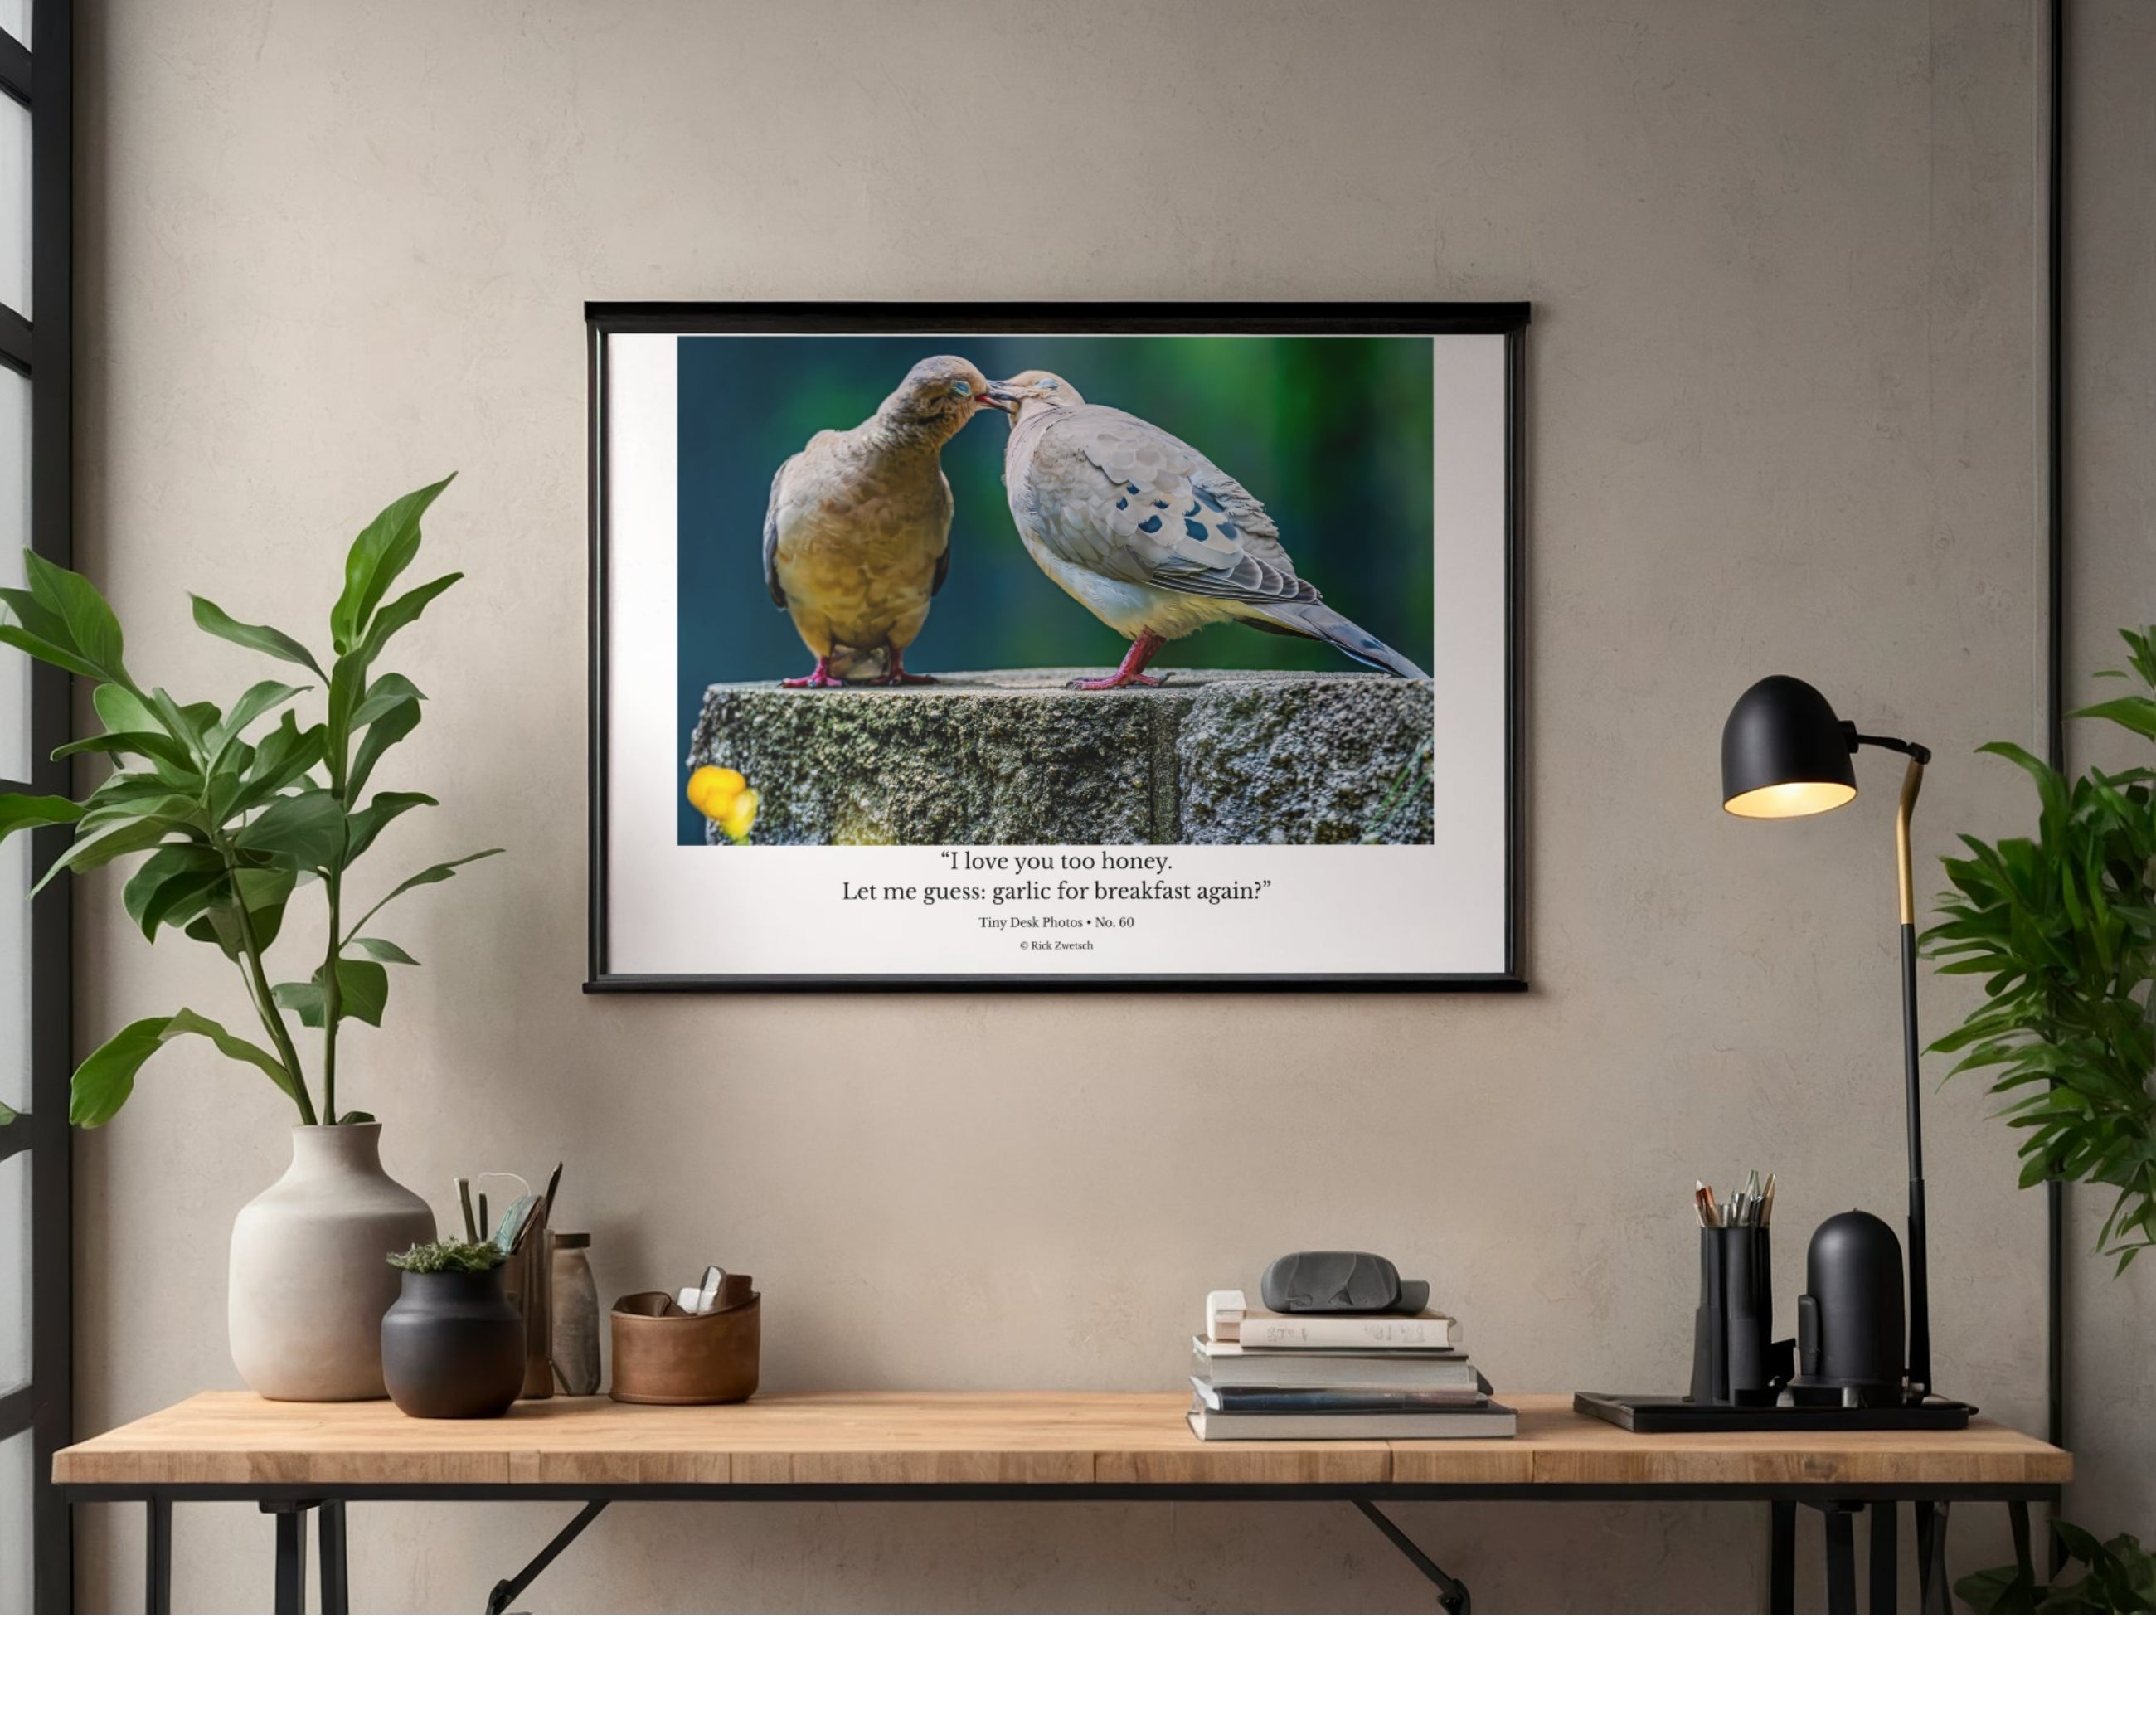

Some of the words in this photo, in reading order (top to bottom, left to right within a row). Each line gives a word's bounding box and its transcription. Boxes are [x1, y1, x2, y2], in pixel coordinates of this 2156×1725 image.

[940, 851, 959, 870] “I
[964, 850, 1008, 871] love
[1013, 856, 1055, 876] you
[1061, 854, 1095, 870] too
[1101, 849, 1173, 876] honey.
[842, 881, 878, 901] Let
[883, 887, 917, 901] me
[922, 886, 986, 906] guess:
[992, 880, 1051, 906] garlic
[1056, 879, 1090, 901] for
[1094, 879, 1192, 900] breakfast
[1197, 879, 1272, 906] again?”
[978, 916, 1008, 931] Tiny
[1010, 916, 1040, 928] Desk
[1042, 916, 1084, 928] Photos
[1095, 916, 1116, 928] No.
[1119, 916, 1135, 928] 60
[1031, 940, 1052, 950] Rick
[1054, 940, 1094, 950] Zwetsch
